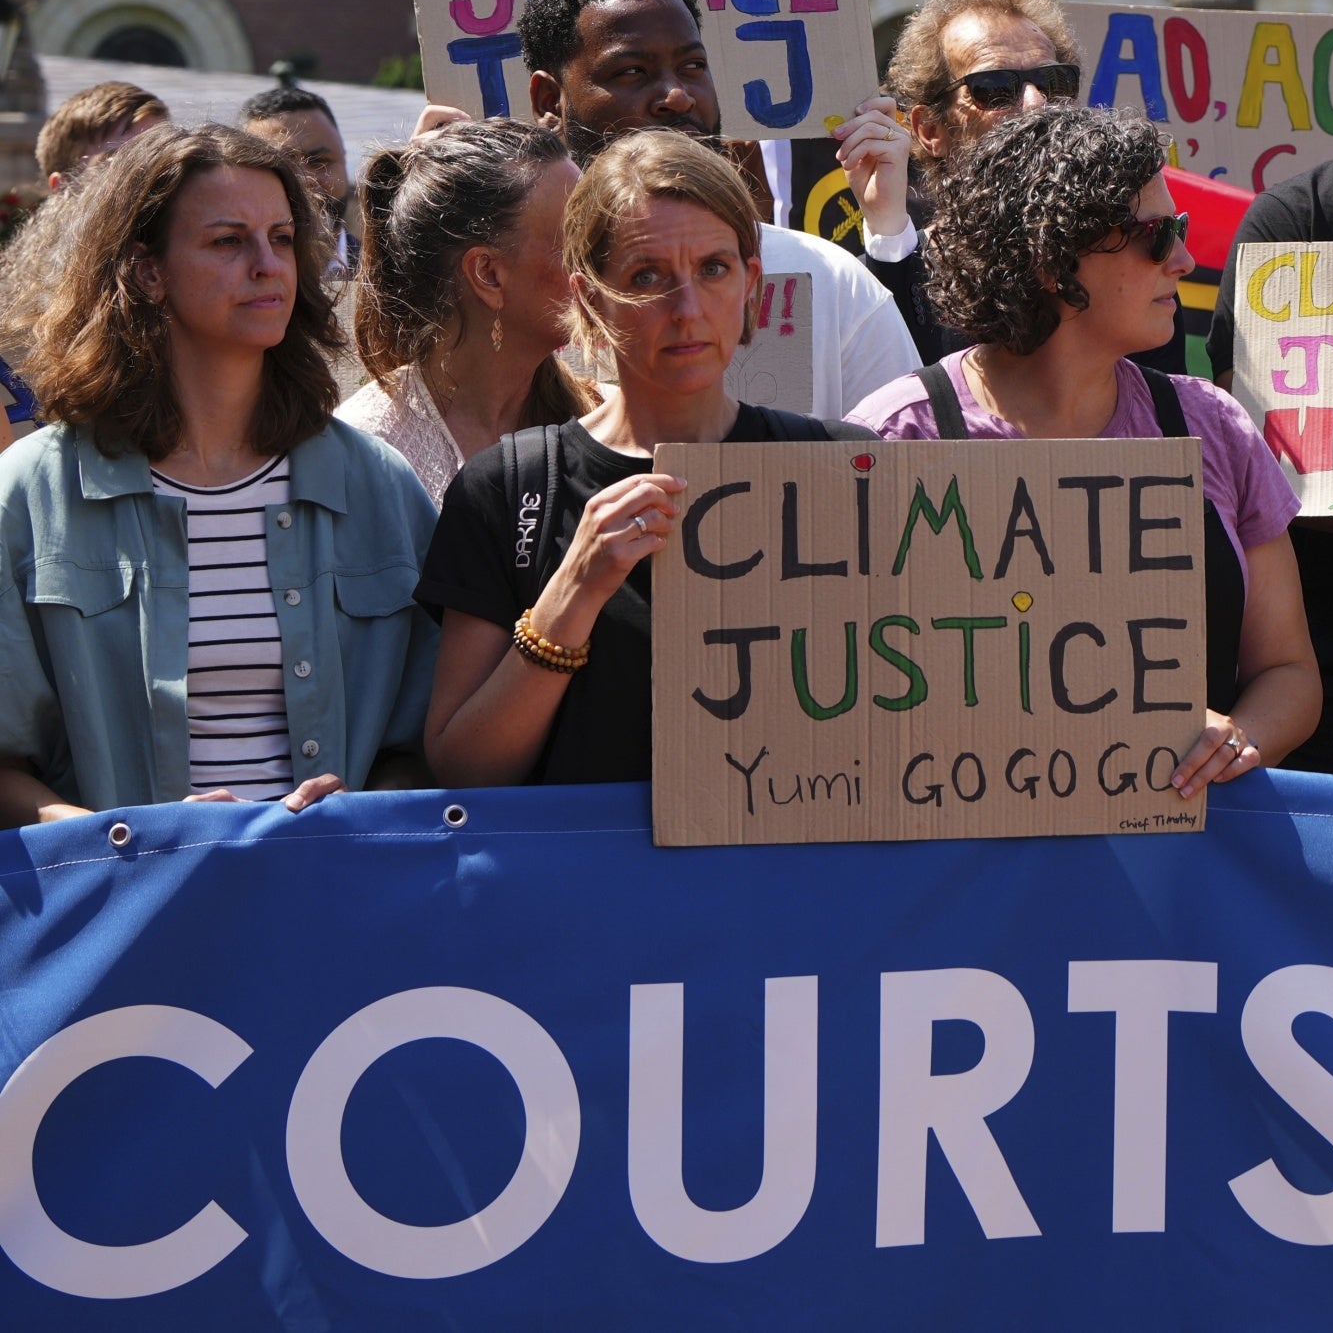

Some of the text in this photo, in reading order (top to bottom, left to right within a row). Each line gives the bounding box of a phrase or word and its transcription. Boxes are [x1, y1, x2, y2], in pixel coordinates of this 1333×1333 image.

[516, 492, 542, 567] DAKINE
[726, 746, 862, 814] Yumi
[902, 752, 987, 807] GO
[1005, 747, 1077, 798] GO
